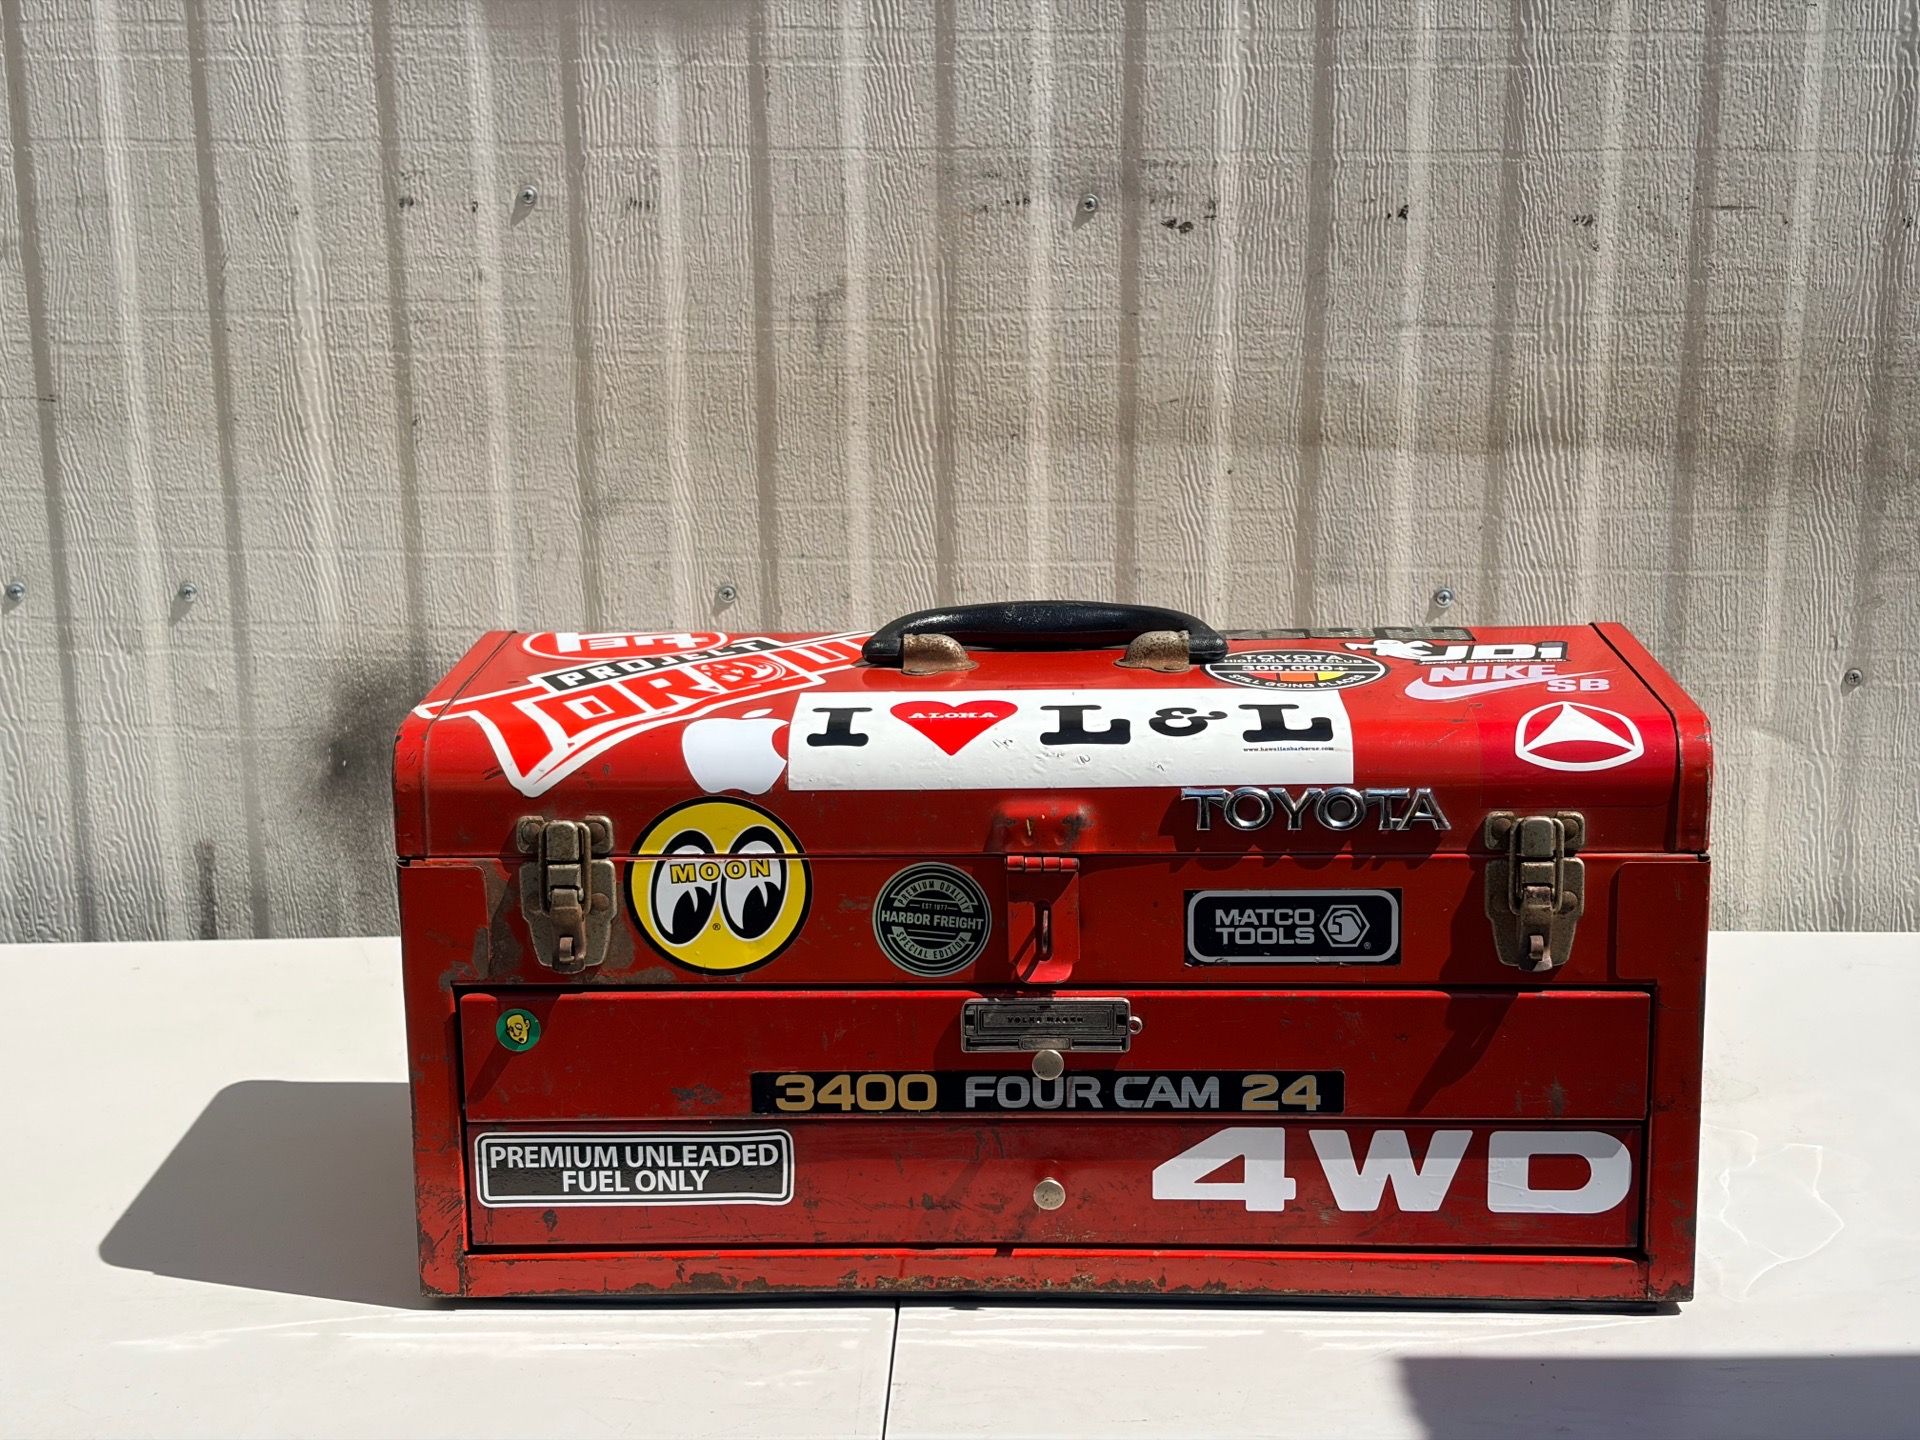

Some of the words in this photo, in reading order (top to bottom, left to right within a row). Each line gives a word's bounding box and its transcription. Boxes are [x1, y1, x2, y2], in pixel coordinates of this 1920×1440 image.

[1229, 674, 1261, 685] STILL
[1318, 674, 1367, 687] PLACES
[1428, 664, 1558, 682] NIKE
[1547, 678, 1610, 692] SB
[806, 706, 873, 748] I
[908, 711, 999, 719] ALOHA
[1181, 786, 1452, 831] TOYOTA
[669, 858, 771, 884] MOON
[897, 880, 935, 906] PREMIUM
[940, 881, 971, 912] QUALITY
[881, 910, 931, 926] HARBOR
[934, 914, 985, 931] FREIGHT
[1215, 908, 1315, 926] MATCO
[896, 931, 929, 959] SPECIAL
[933, 937, 967, 959] EDITION
[1215, 927, 1315, 945] TOOLS
[775, 1074, 938, 1112] 3400
[965, 1076, 1102, 1110] FOUR
[1115, 1076, 1220, 1109] CAM
[1242, 1074, 1321, 1111] 24
[489, 1146, 618, 1169] PREMIUM
[626, 1144, 779, 1168] UNLEADED
[562, 1170, 630, 1193] FUEL
[634, 1169, 710, 1192] ONLY
[1152, 1127, 1632, 1213] 4WD
